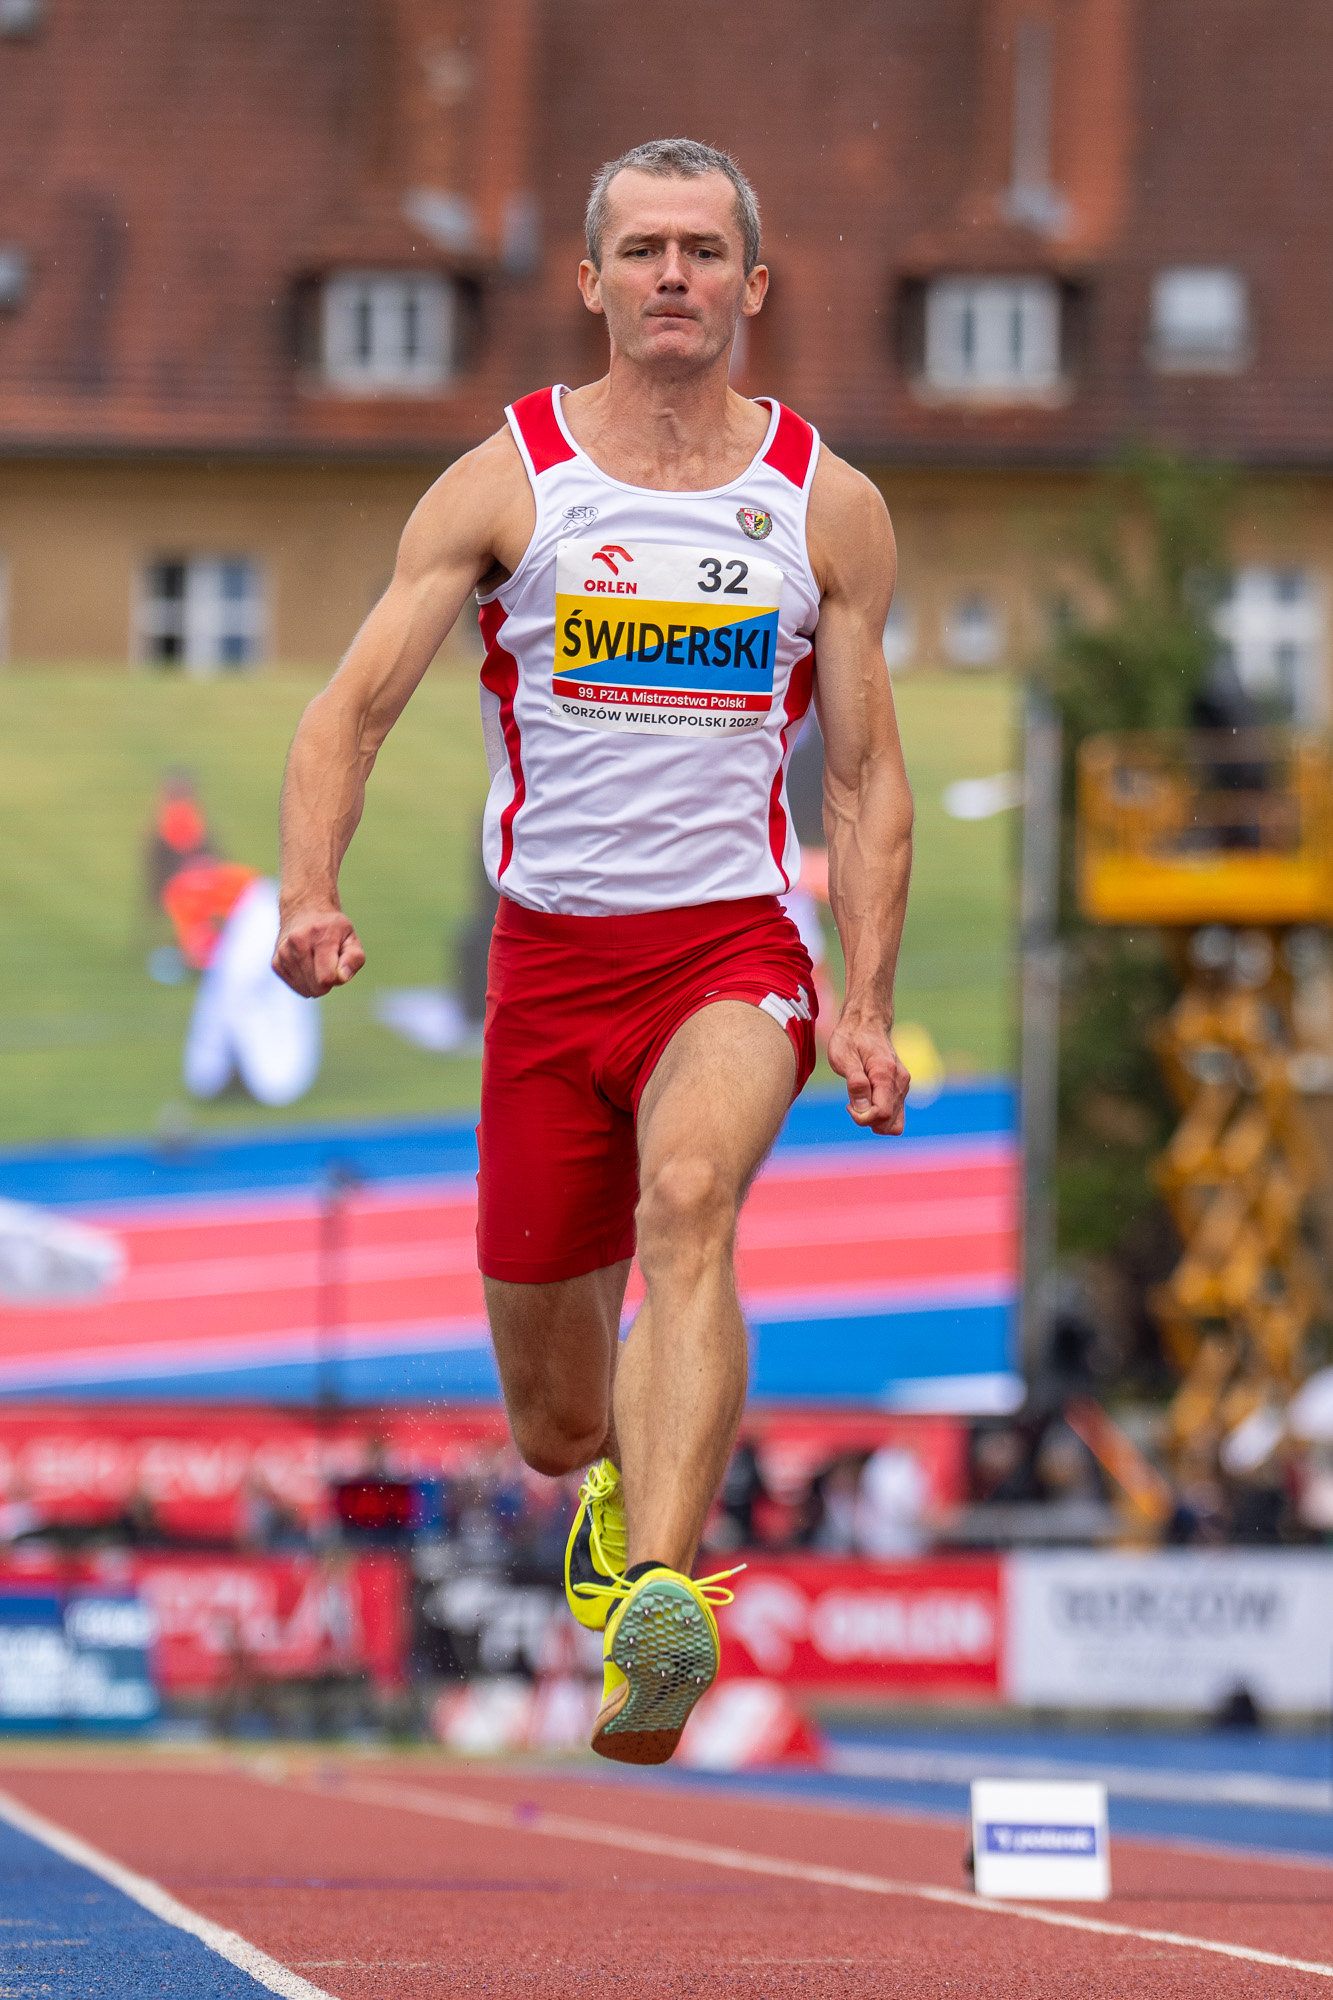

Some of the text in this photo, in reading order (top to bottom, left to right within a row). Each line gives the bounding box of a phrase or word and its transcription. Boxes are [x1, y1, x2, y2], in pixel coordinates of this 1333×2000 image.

[583, 579, 638, 595] ORLEN
[697, 558, 749, 595] 32
[562, 609, 770, 670] ŚWIDERSKI
[578, 686, 747, 709] 99. PZLA Mistrzostwa Polski
[562, 703, 759, 728] GORZÓW WIELKOPOLSKI 2023
